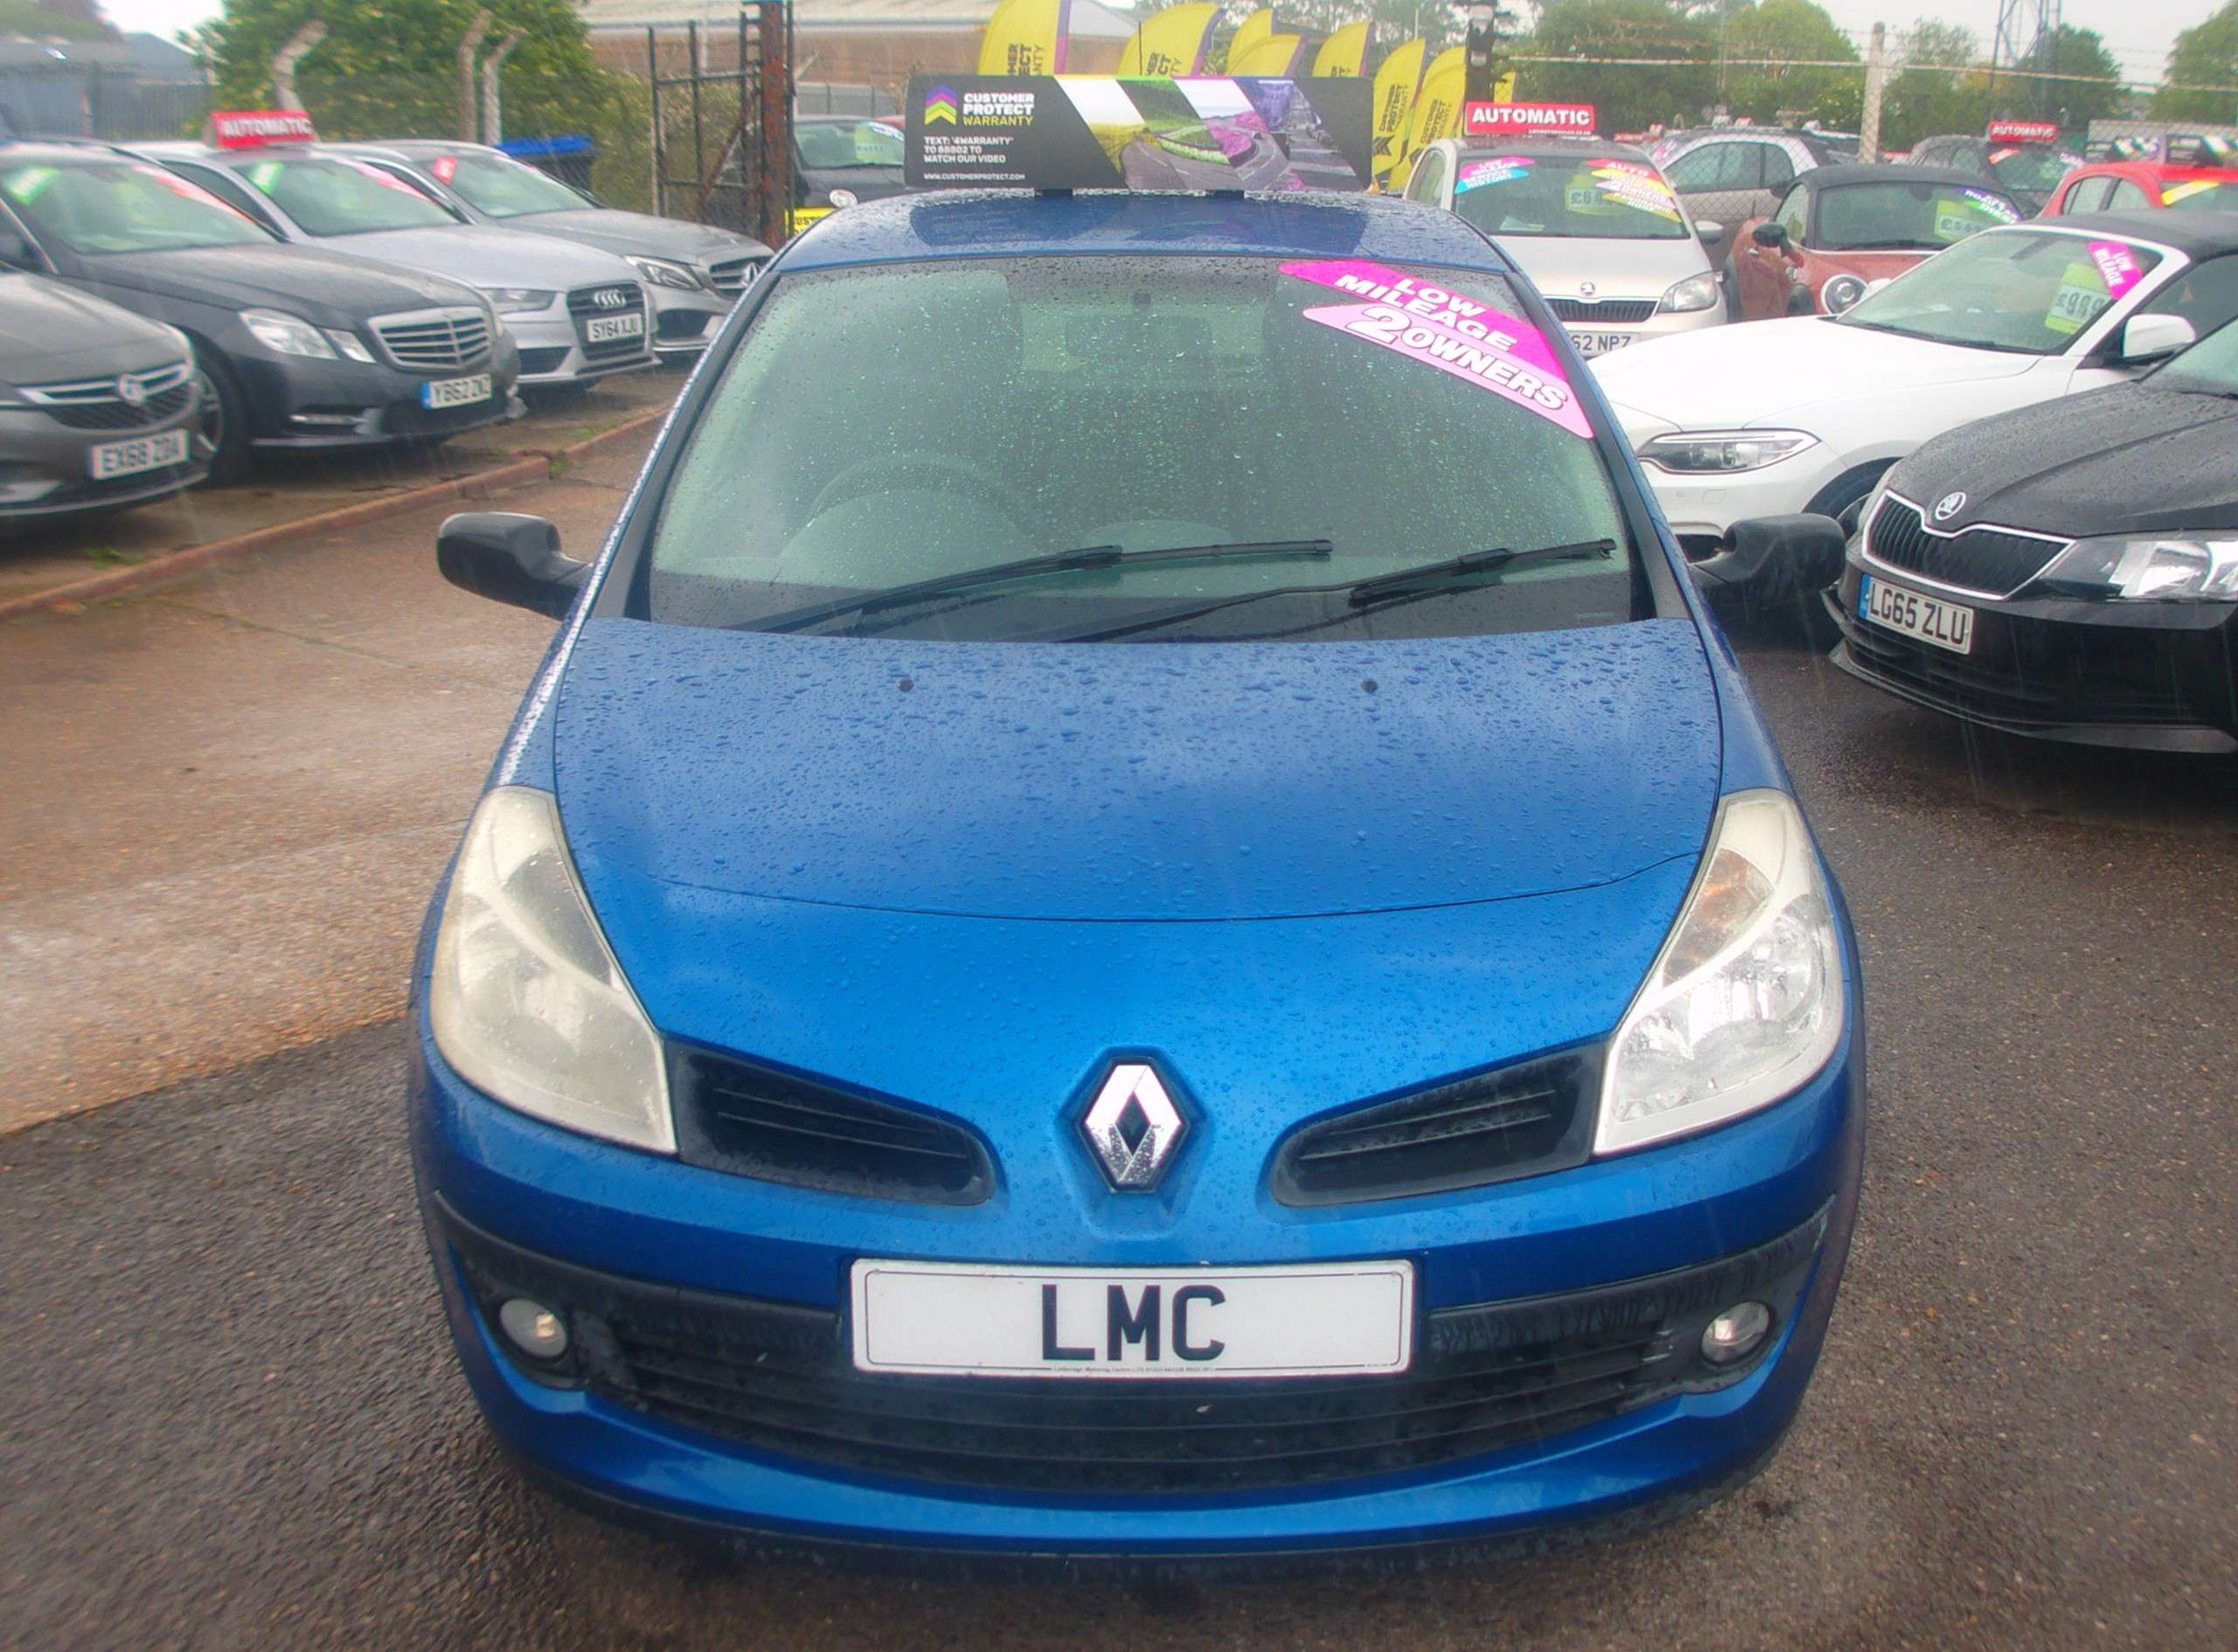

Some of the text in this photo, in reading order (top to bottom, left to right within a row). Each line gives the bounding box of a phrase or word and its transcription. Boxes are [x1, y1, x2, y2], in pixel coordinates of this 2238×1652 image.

[963, 93, 1034, 103] CUSTOMER
[963, 103, 1034, 115] PROTECT
[1471, 108, 1591, 126] AUTOMATIC
[223, 118, 312, 138] AUTOMATIC
[963, 115, 1033, 126] WARRANTY
[1992, 125, 2054, 138] AUTOMATIC
[923, 145, 936, 154] TO
[970, 145, 982, 154] TO
[923, 154, 1006, 163] WATCH OUR VIDEO
[1607, 162, 1649, 177] AUTO
[2094, 248, 2124, 287] MILEAGE
[2111, 251, 2133, 272] LOW
[1395, 277, 1486, 318] LOW
[1334, 274, 1519, 351] MILEAGE
[1400, 326, 1568, 410] OWNERS
[1869, 583, 1966, 645] LG65 ZLU
[1040, 1283, 1227, 1362] LMC
